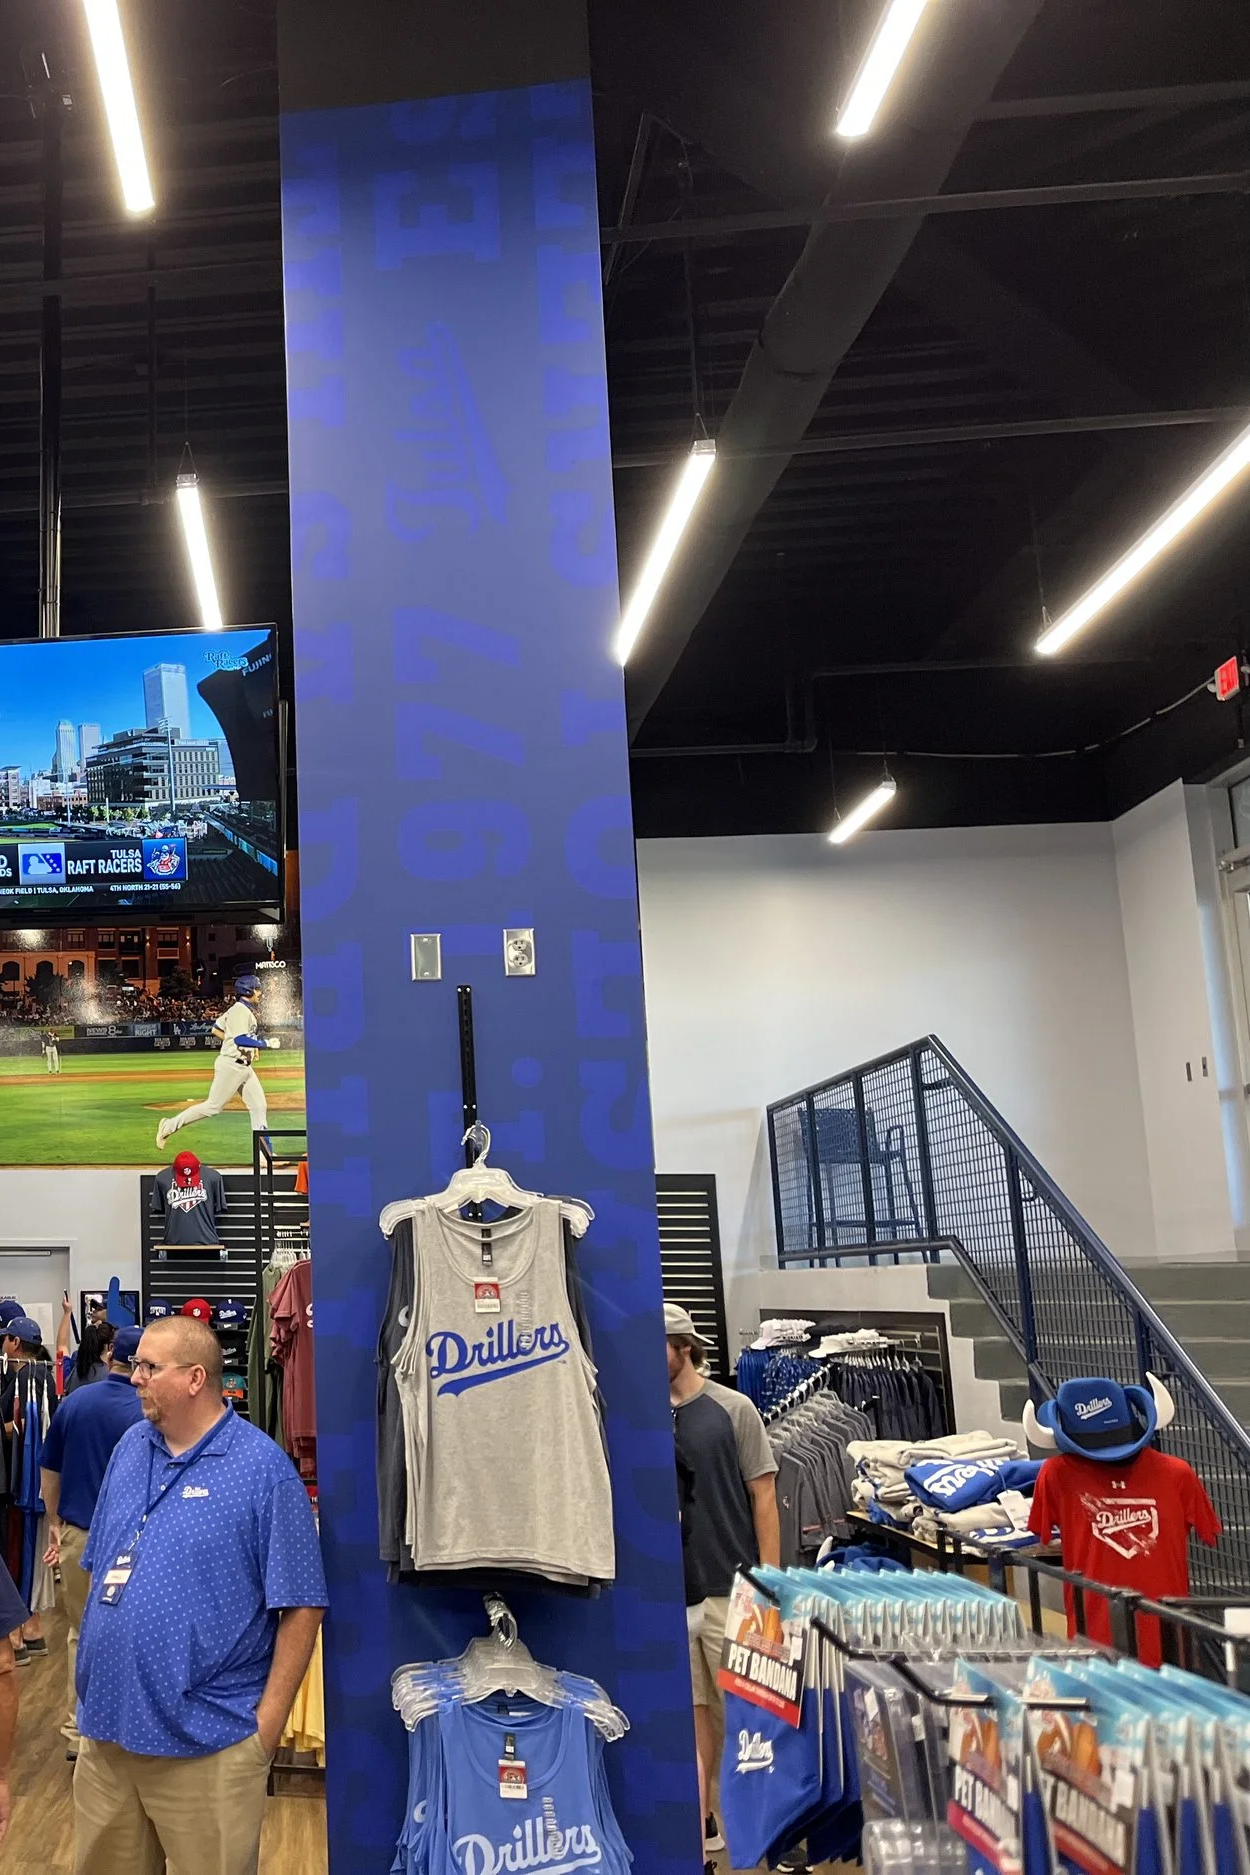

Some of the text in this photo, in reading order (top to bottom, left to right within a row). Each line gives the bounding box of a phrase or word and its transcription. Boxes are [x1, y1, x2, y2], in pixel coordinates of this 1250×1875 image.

[110, 849, 141, 859] TULSA
[67, 859, 142, 875] RAFT RACERS
[15, 887, 33, 895] FIELD
[122, 884, 143, 892] NORTH
[425, 1319, 567, 1380] Drillers
[1075, 1396, 1112, 1417] Drillers
[1096, 1507, 1151, 1529] Drillers
[728, 1642, 750, 1676] PET
[750, 1652, 798, 1700] BANDANA
[954, 1764, 975, 1812] PET
[452, 1817, 598, 1875] Drillers
